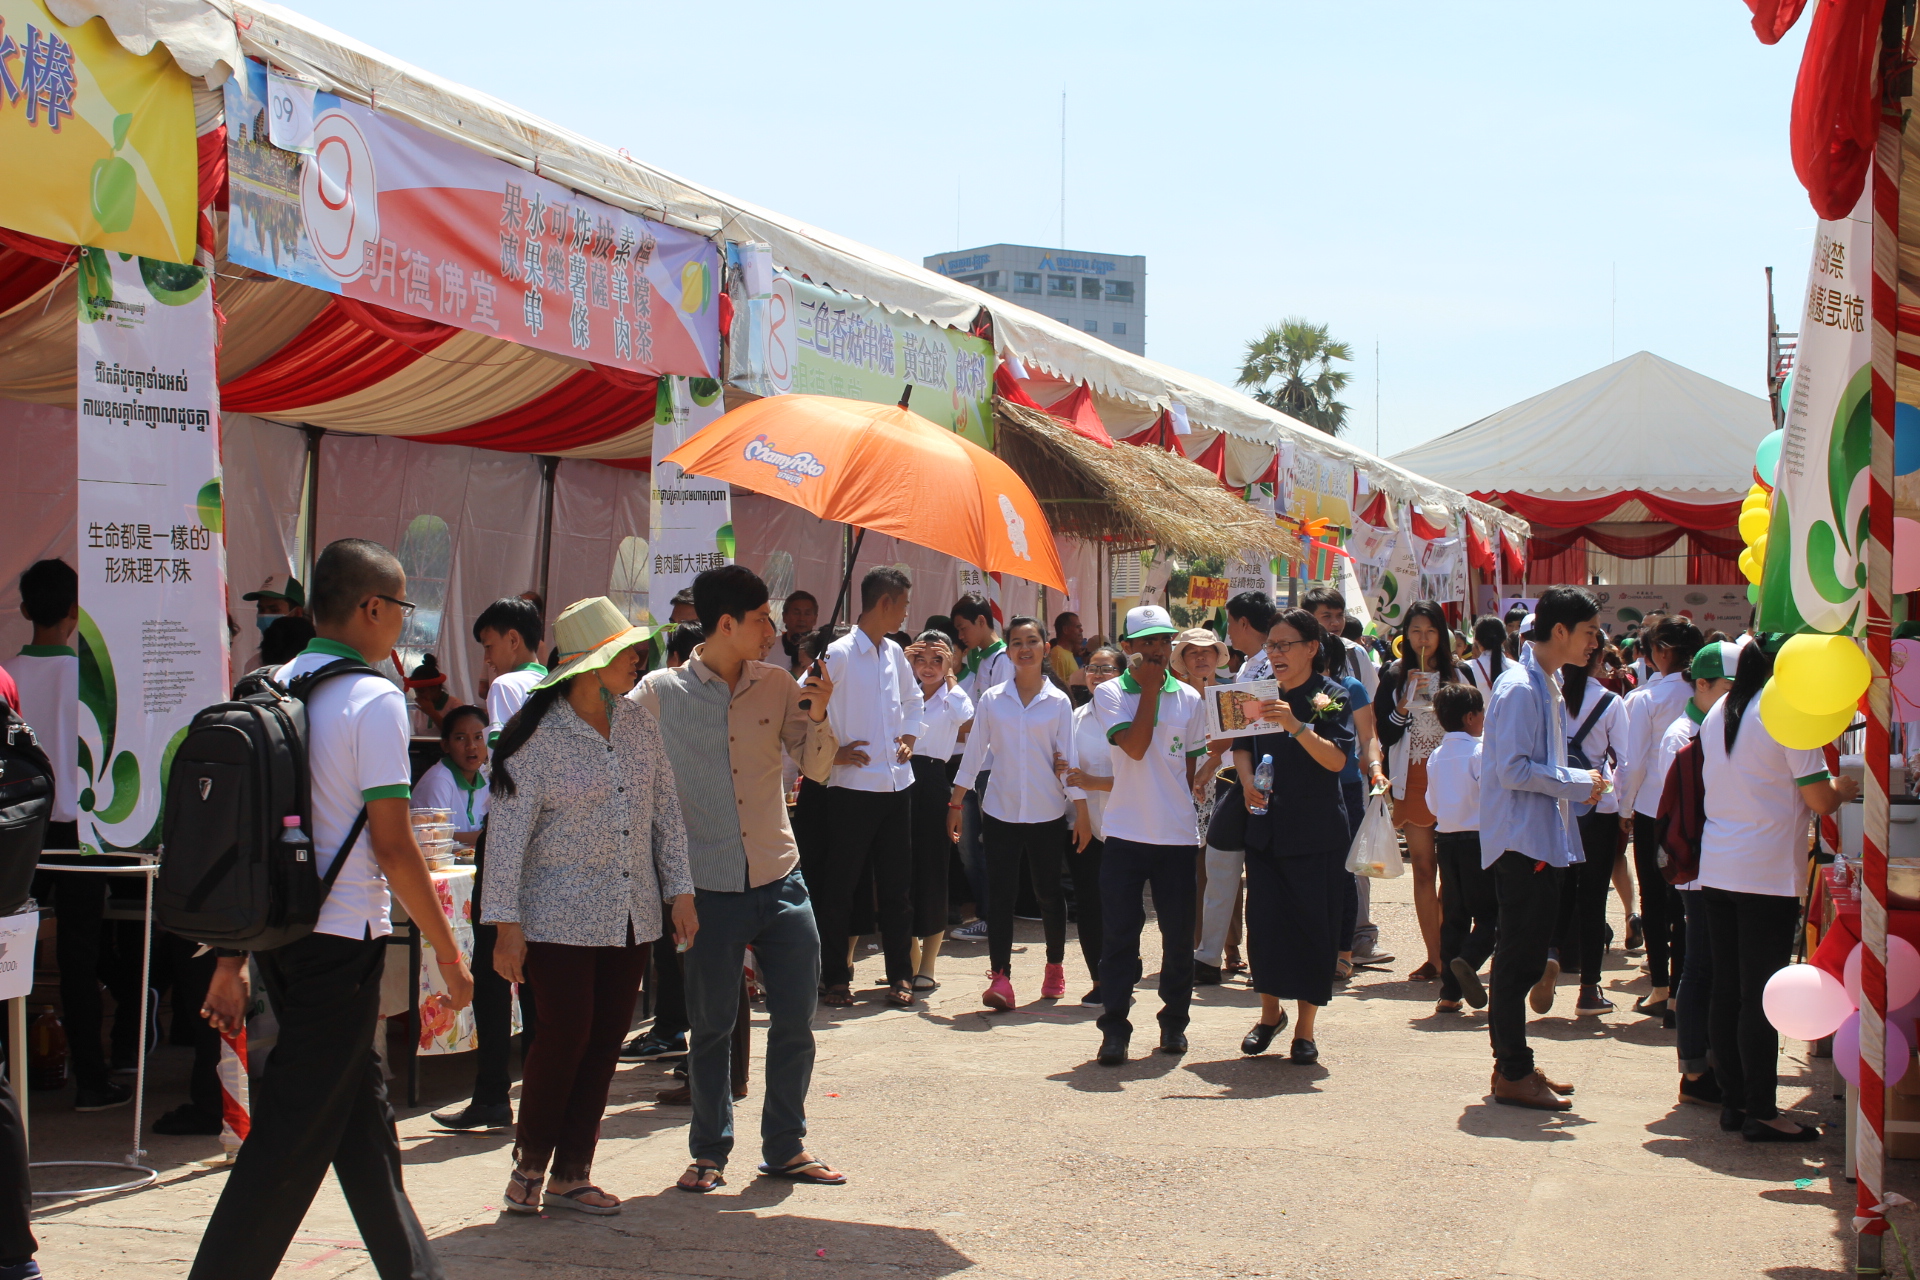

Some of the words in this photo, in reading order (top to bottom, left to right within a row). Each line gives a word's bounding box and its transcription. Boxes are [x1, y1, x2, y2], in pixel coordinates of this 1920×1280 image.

[273, 95, 294, 123] 09
[316, 136, 356, 260] 9
[363, 237, 499, 332] 明德佛堂
[524, 190, 547, 337] 水果串
[547, 200, 570, 295] 可樂
[569, 206, 592, 350] 炸薯條
[590, 216, 615, 309] 披薩
[611, 225, 636, 361] 素羊肉
[633, 230, 656, 364] 檸檬茶
[768, 293, 788, 380] 8
[797, 301, 896, 377] 三色香菇串燒
[902, 331, 948, 393] 黃金餃
[956, 346, 986, 403] 飲料
[88, 522, 210, 550] 生命都是一樣的
[105, 557, 192, 583] 形殊理不殊
[654, 552, 725, 575] 食肉斷大悲種
